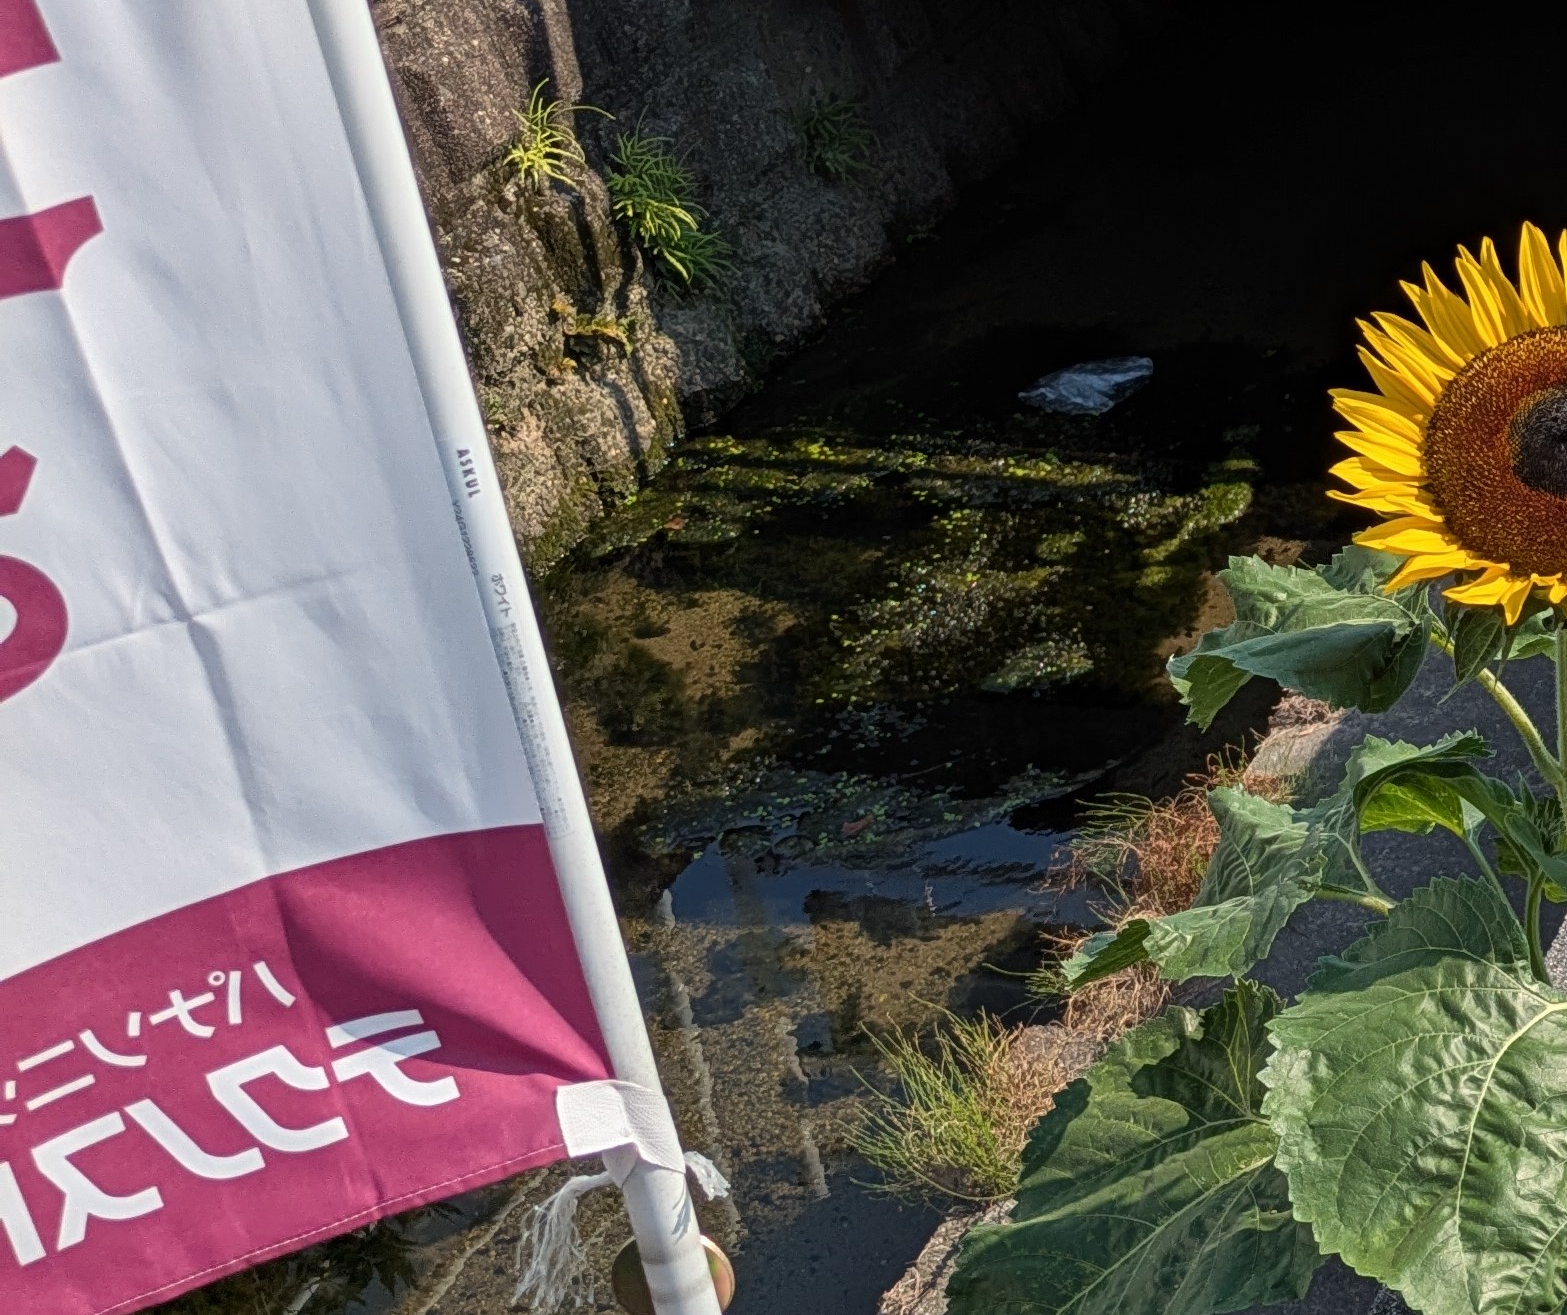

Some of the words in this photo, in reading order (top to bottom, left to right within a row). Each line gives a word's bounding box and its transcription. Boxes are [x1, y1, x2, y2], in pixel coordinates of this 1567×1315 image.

[456, 448, 481, 499] ASKUL
[491, 572, 513, 619] ホワイト
